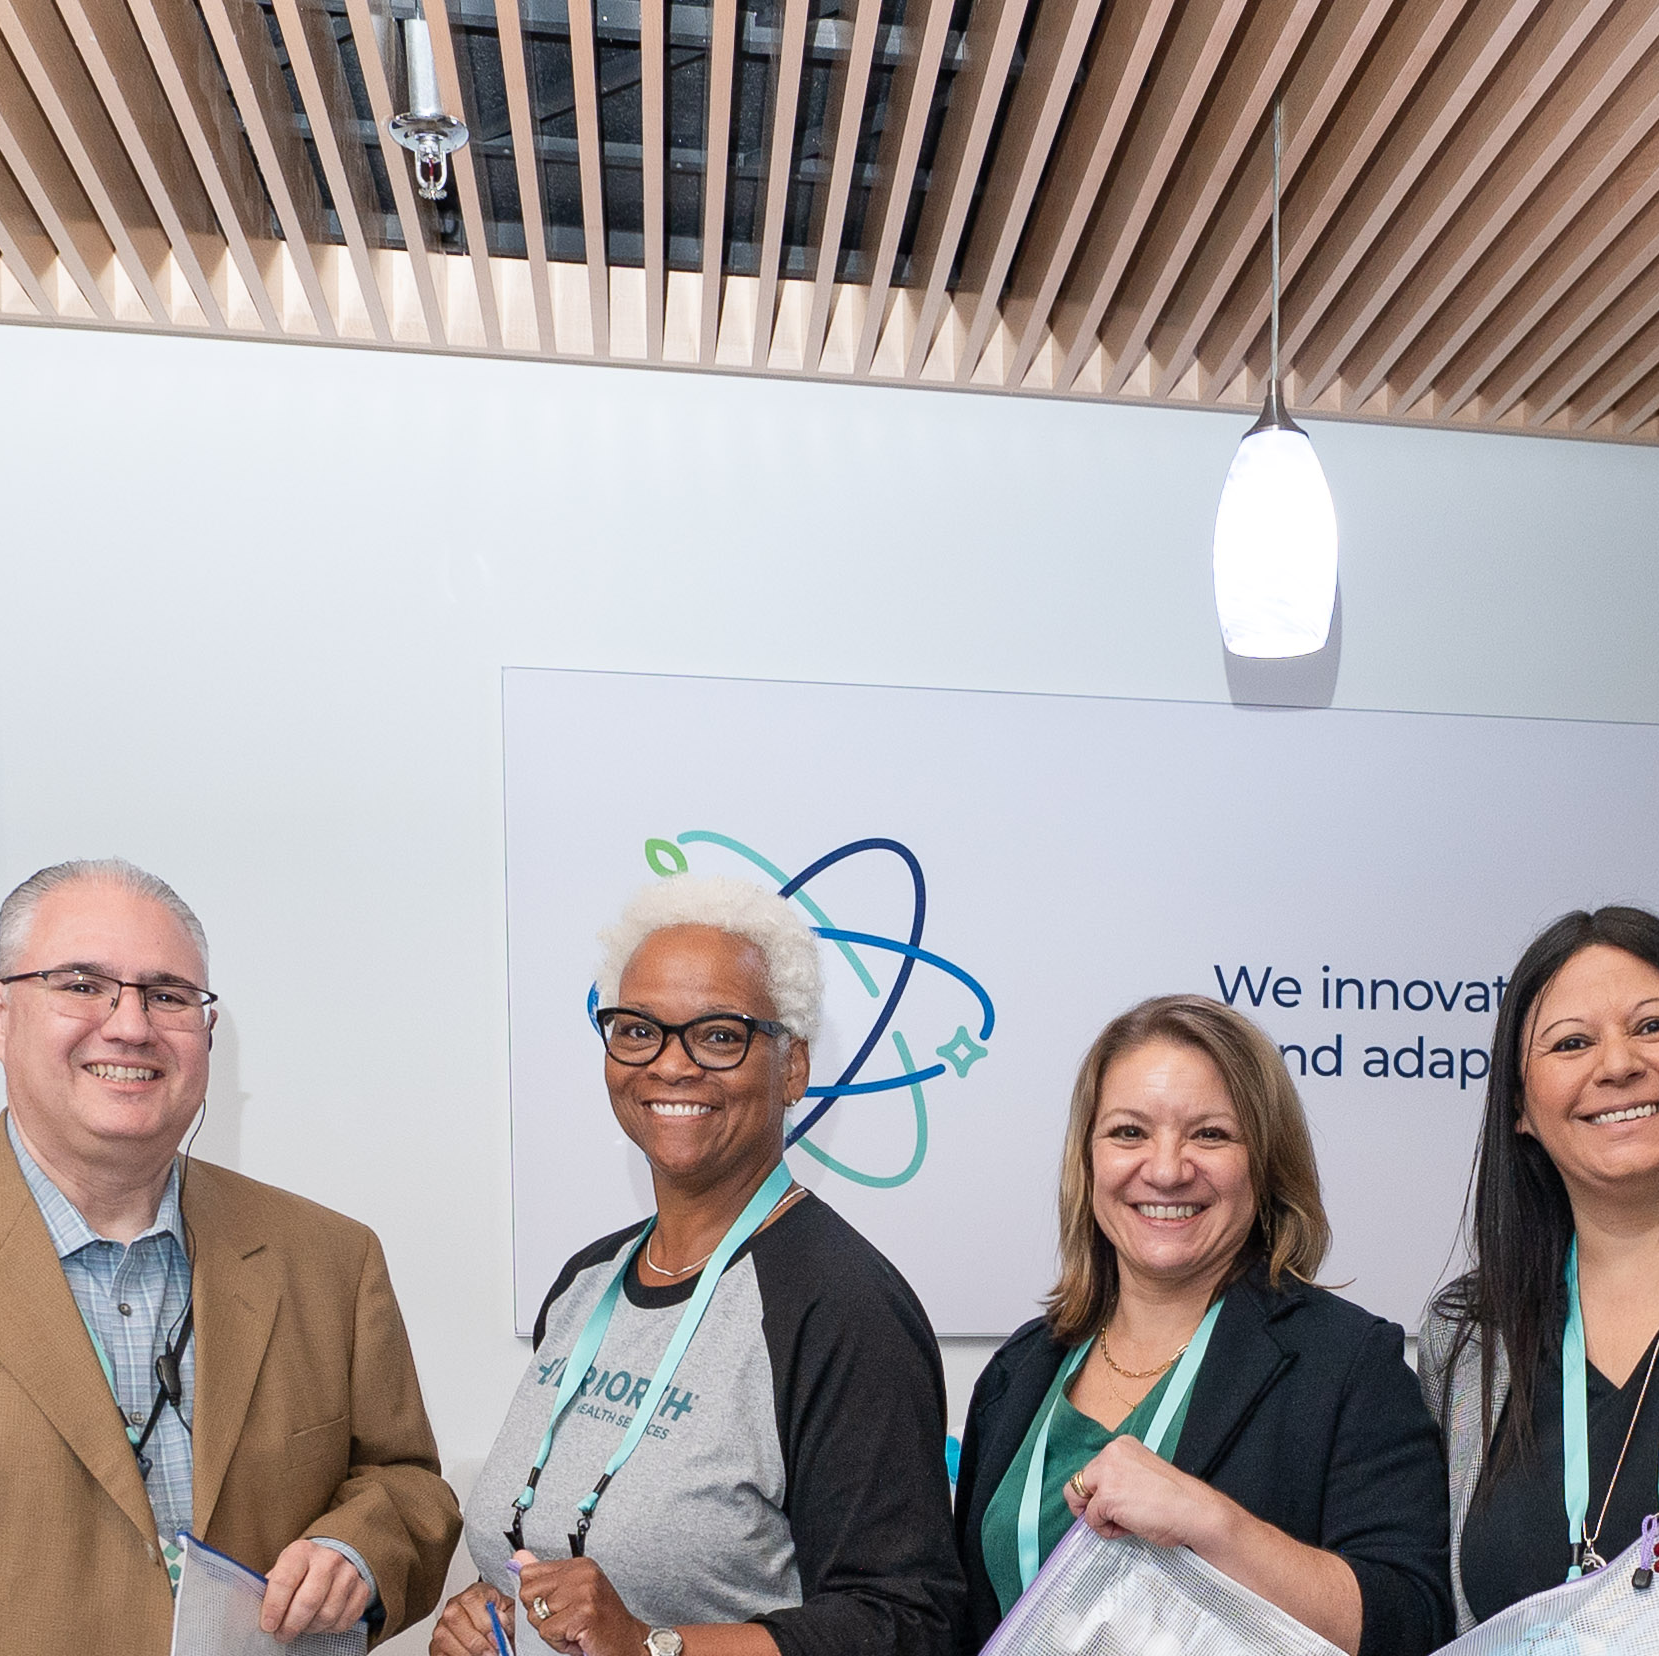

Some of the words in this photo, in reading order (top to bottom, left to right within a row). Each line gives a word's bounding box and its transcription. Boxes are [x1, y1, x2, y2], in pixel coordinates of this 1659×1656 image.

[1214, 965, 1302, 1008] We
[1322, 965, 1508, 1013] innovat
[1279, 1034, 1342, 1077] nd
[1363, 1036, 1491, 1090] adap
